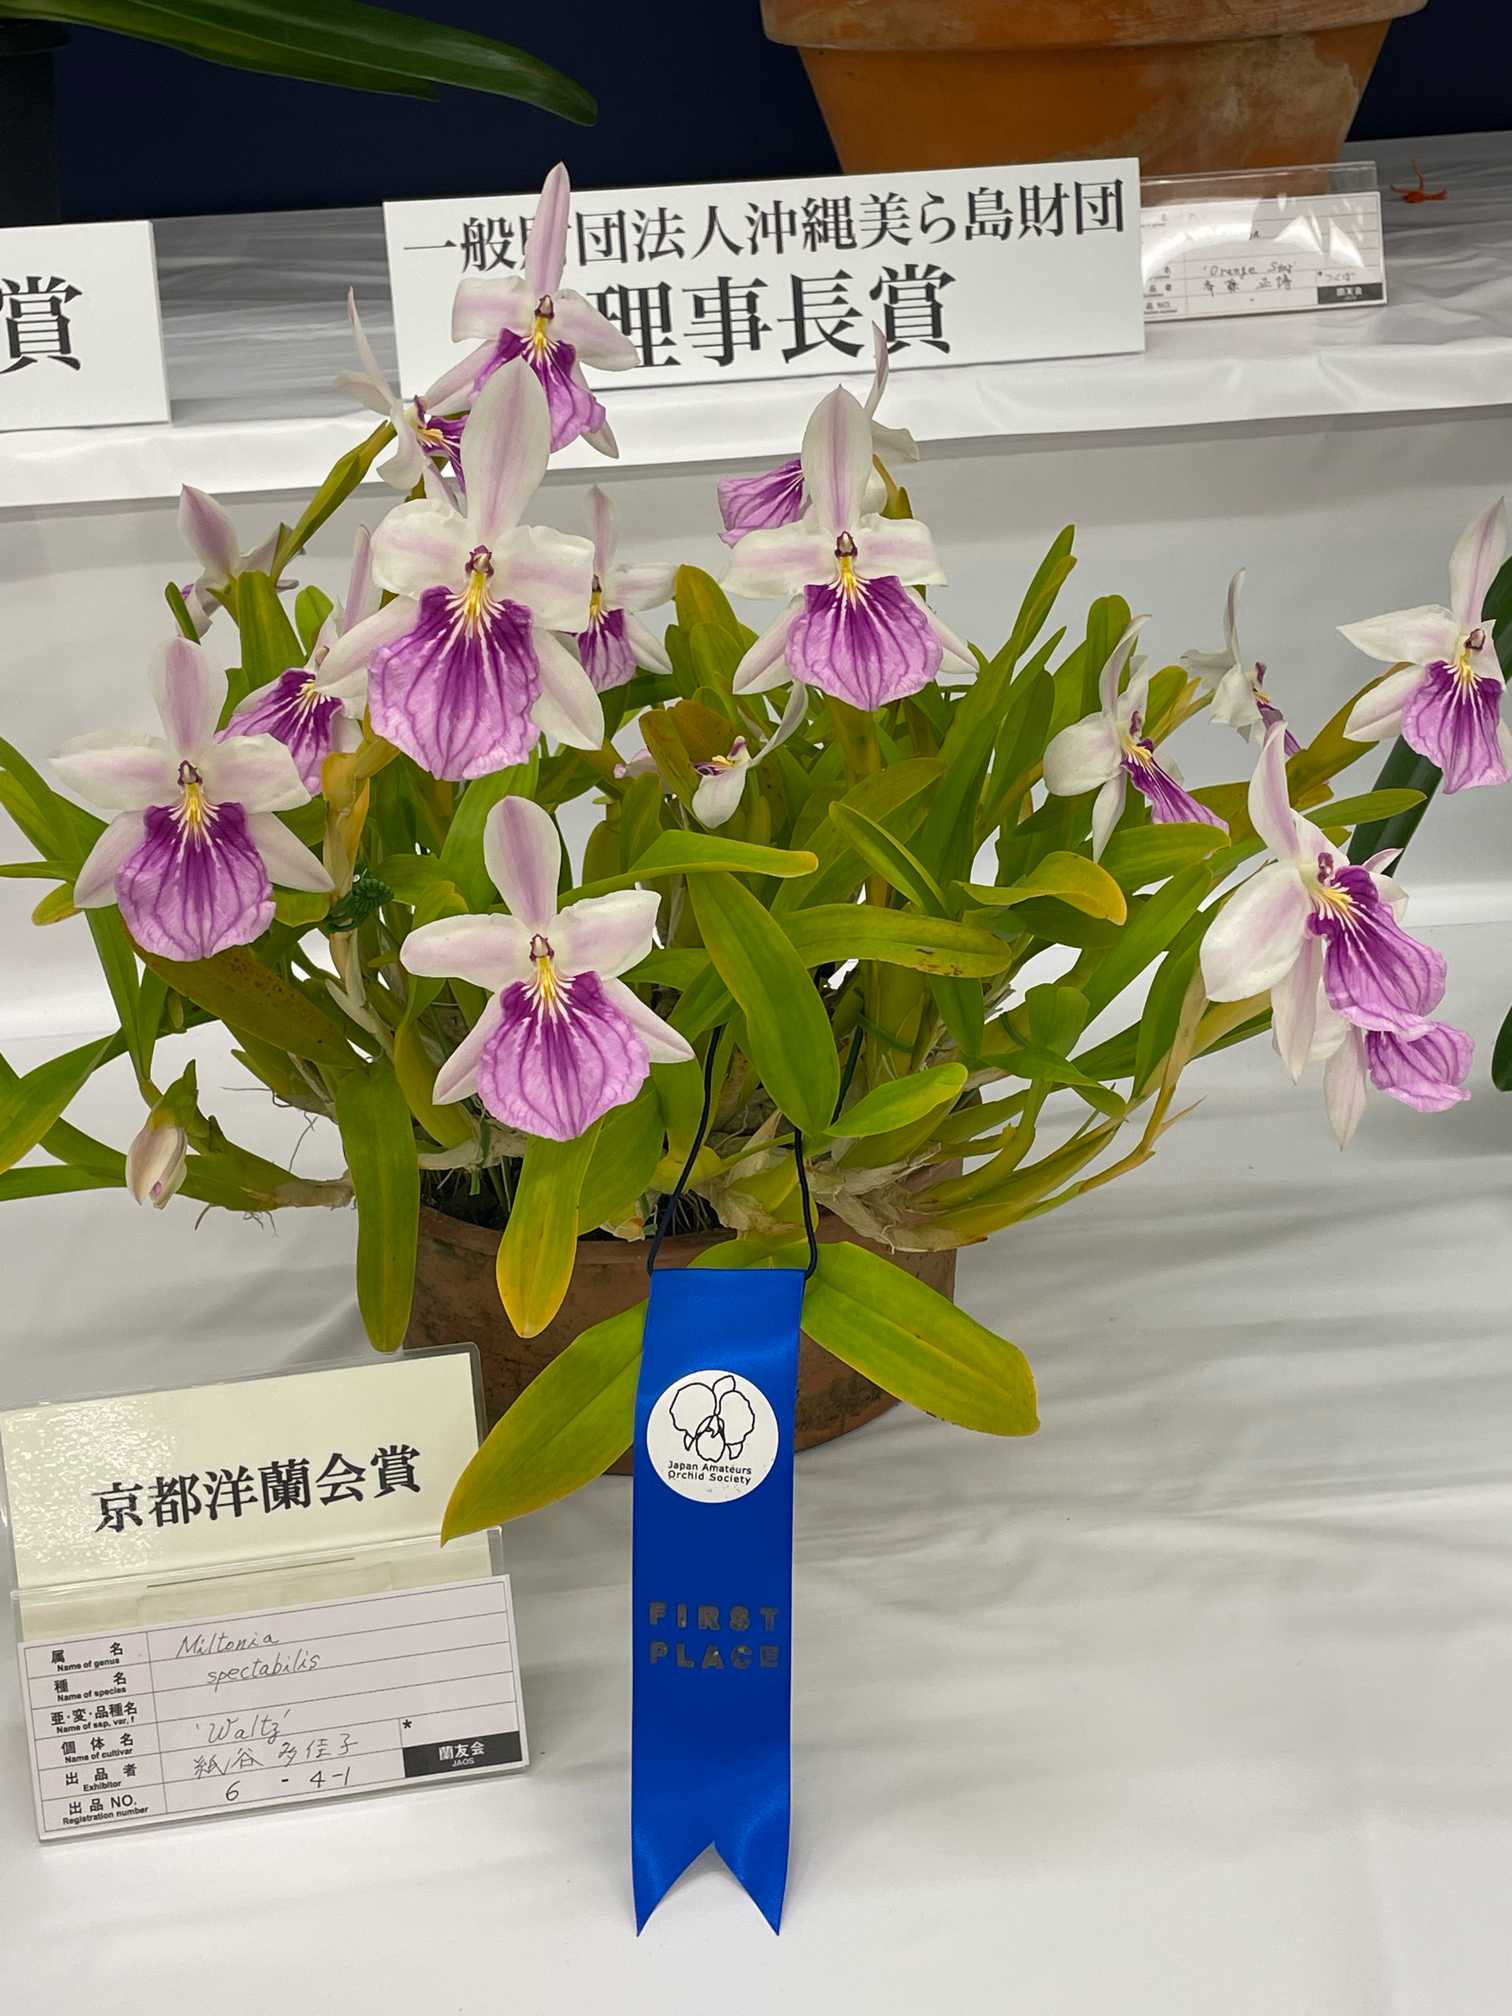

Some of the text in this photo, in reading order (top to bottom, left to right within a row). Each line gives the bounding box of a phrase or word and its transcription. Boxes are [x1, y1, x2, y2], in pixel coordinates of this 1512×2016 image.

[403, 179, 1124, 273] 一般団法人沖縄美ら島財団
[0, 276, 83, 374] 賞
[668, 1460, 752, 1475] Japan Amateurs
[668, 1470, 751, 1485] Orchid Society
[91, 1443, 422, 1533] 京都洋蘭会賞
[649, 1602, 780, 1631] FIRST
[175, 1631, 280, 1659] Miltonia
[57, 1658, 120, 1672] Name of genus
[649, 1641, 780, 1670] PLACE
[207, 1649, 320, 1692] spectabilis
[57, 1686, 127, 1702] Name of species
[56, 1725, 81, 1734] Name
[82, 1722, 91, 1730] of
[65, 1748, 133, 1763] Name of cultivar
[438, 1741, 485, 1761] 蘭友会
[452, 1757, 475, 1767] JAOS
[83, 1781, 122, 1792] Exhibitor
[225, 1780, 241, 1801] 6
[63, 1807, 149, 1825] Registration number
